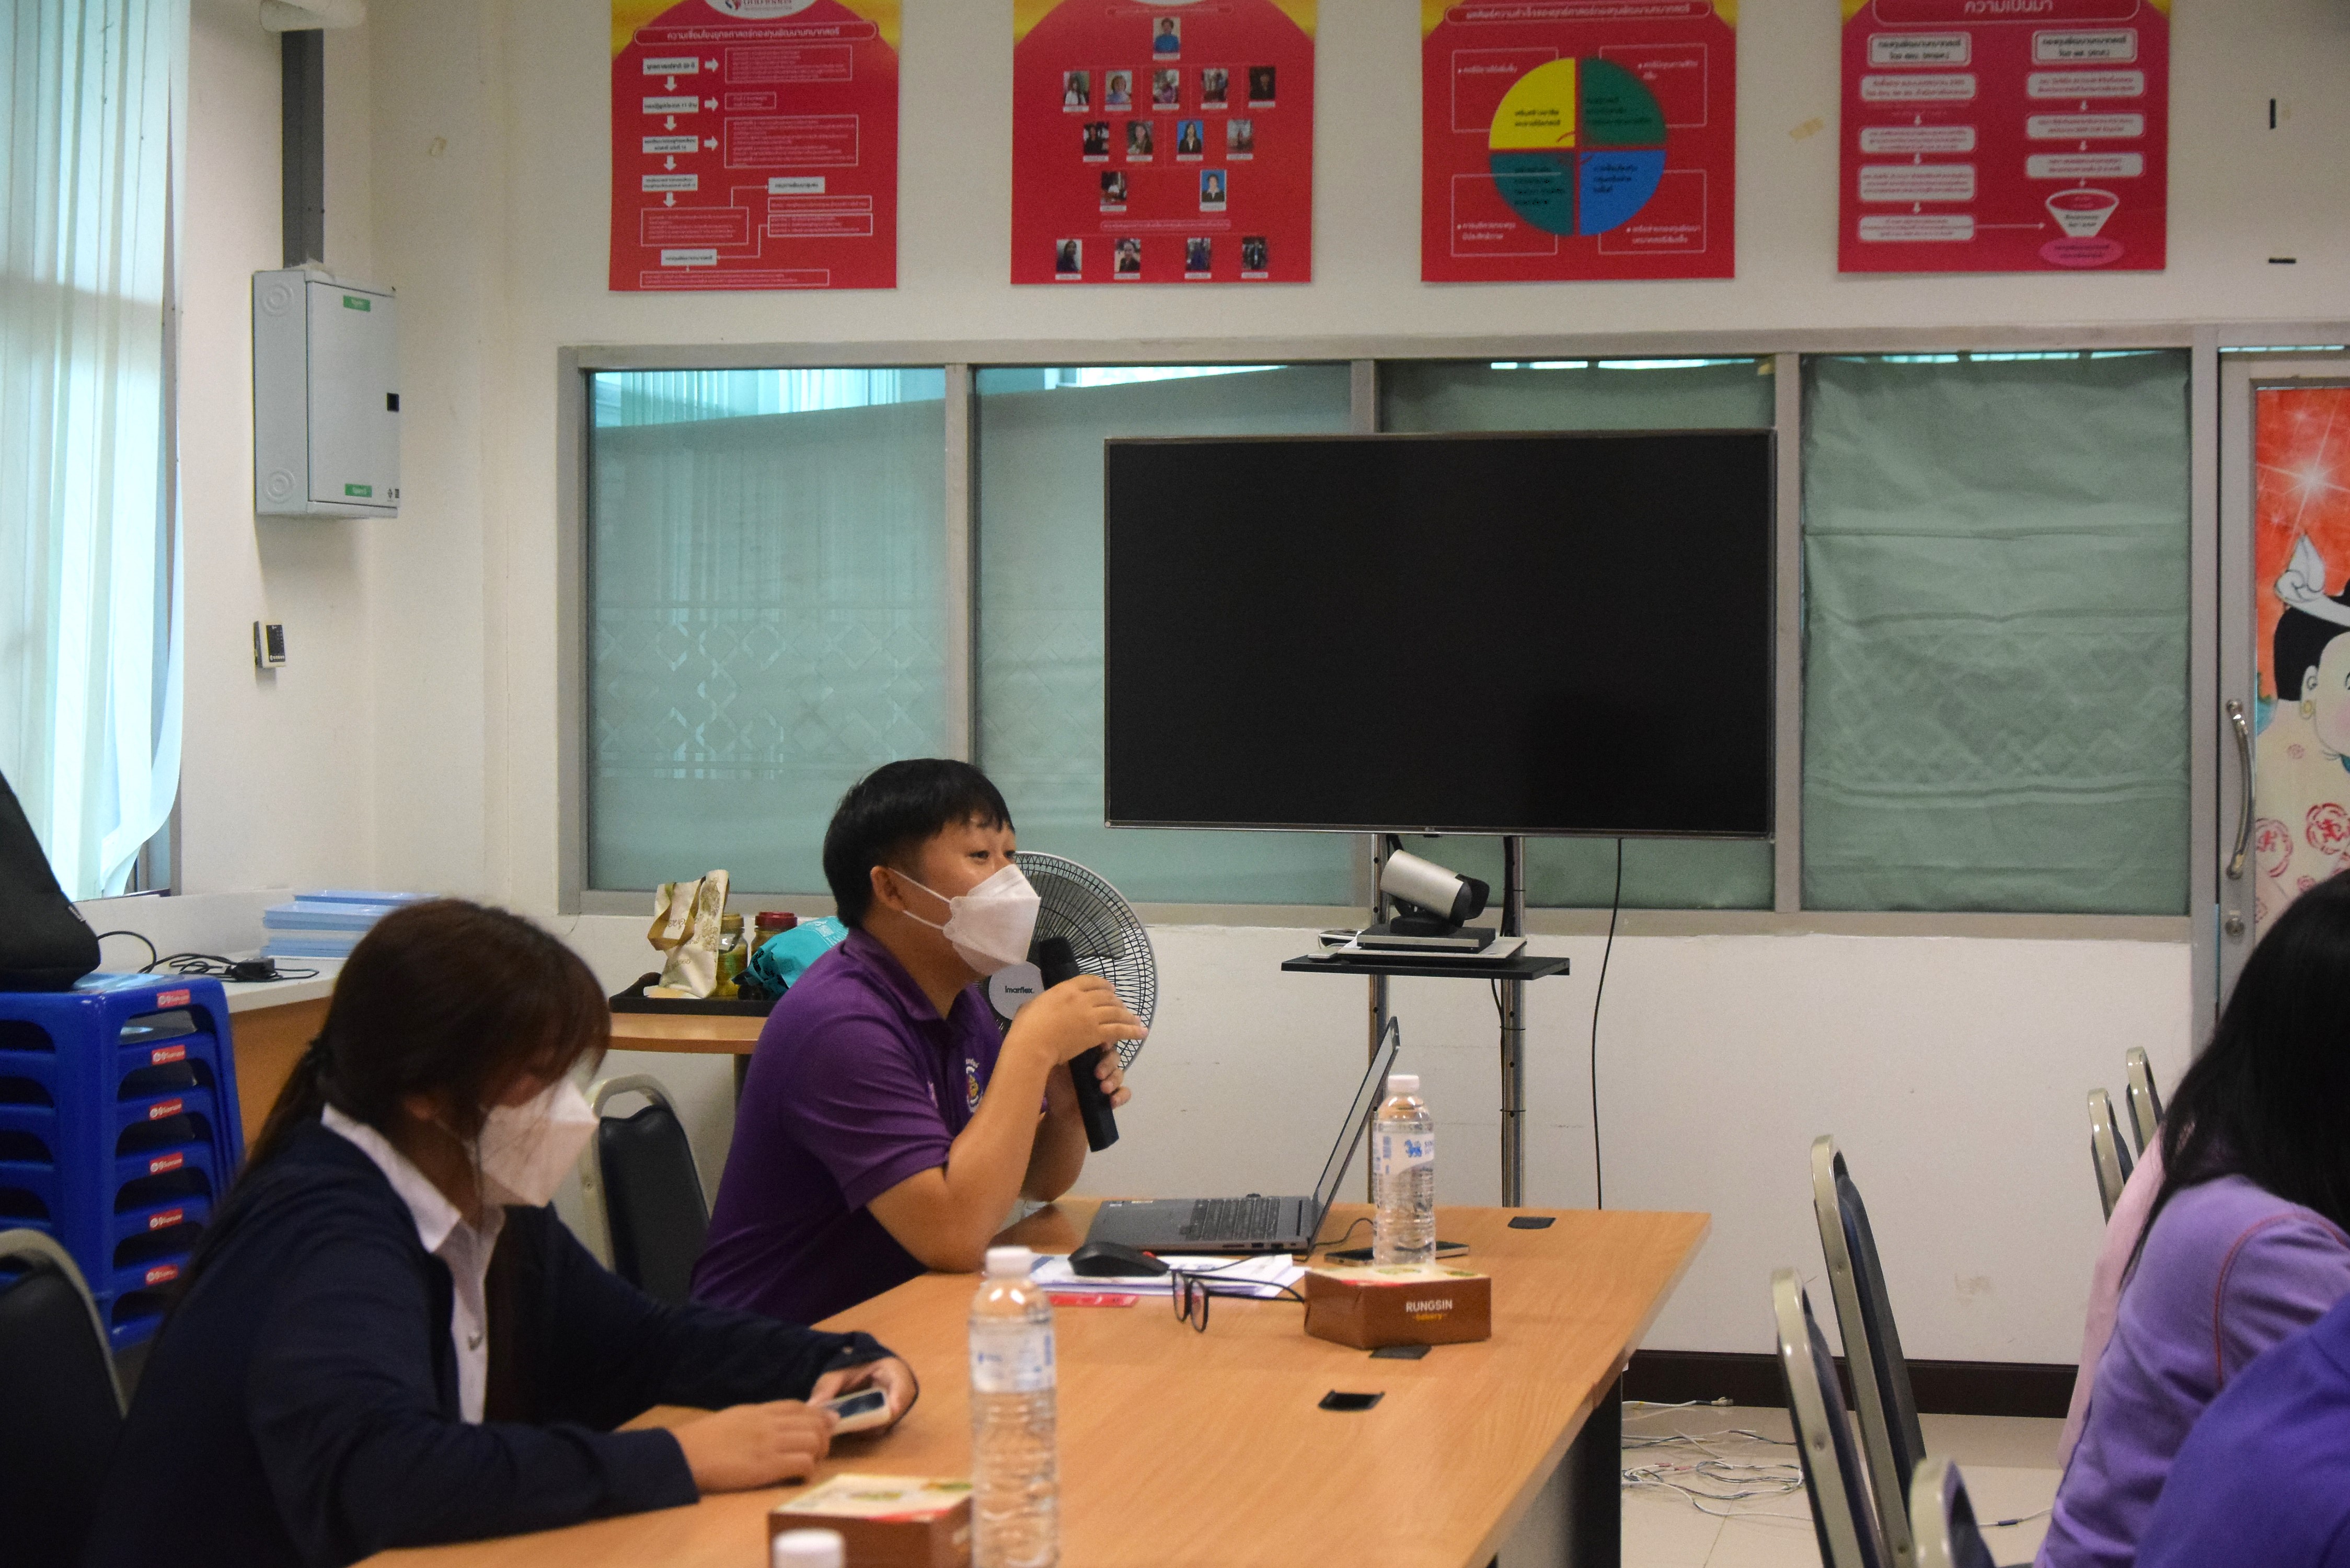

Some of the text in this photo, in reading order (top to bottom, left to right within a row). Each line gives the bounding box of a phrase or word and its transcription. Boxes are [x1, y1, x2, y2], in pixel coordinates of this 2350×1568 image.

[1965, 0, 2053, 14] ความเปนมา
[1406, 1299, 1453, 1313] RUNGSIN
